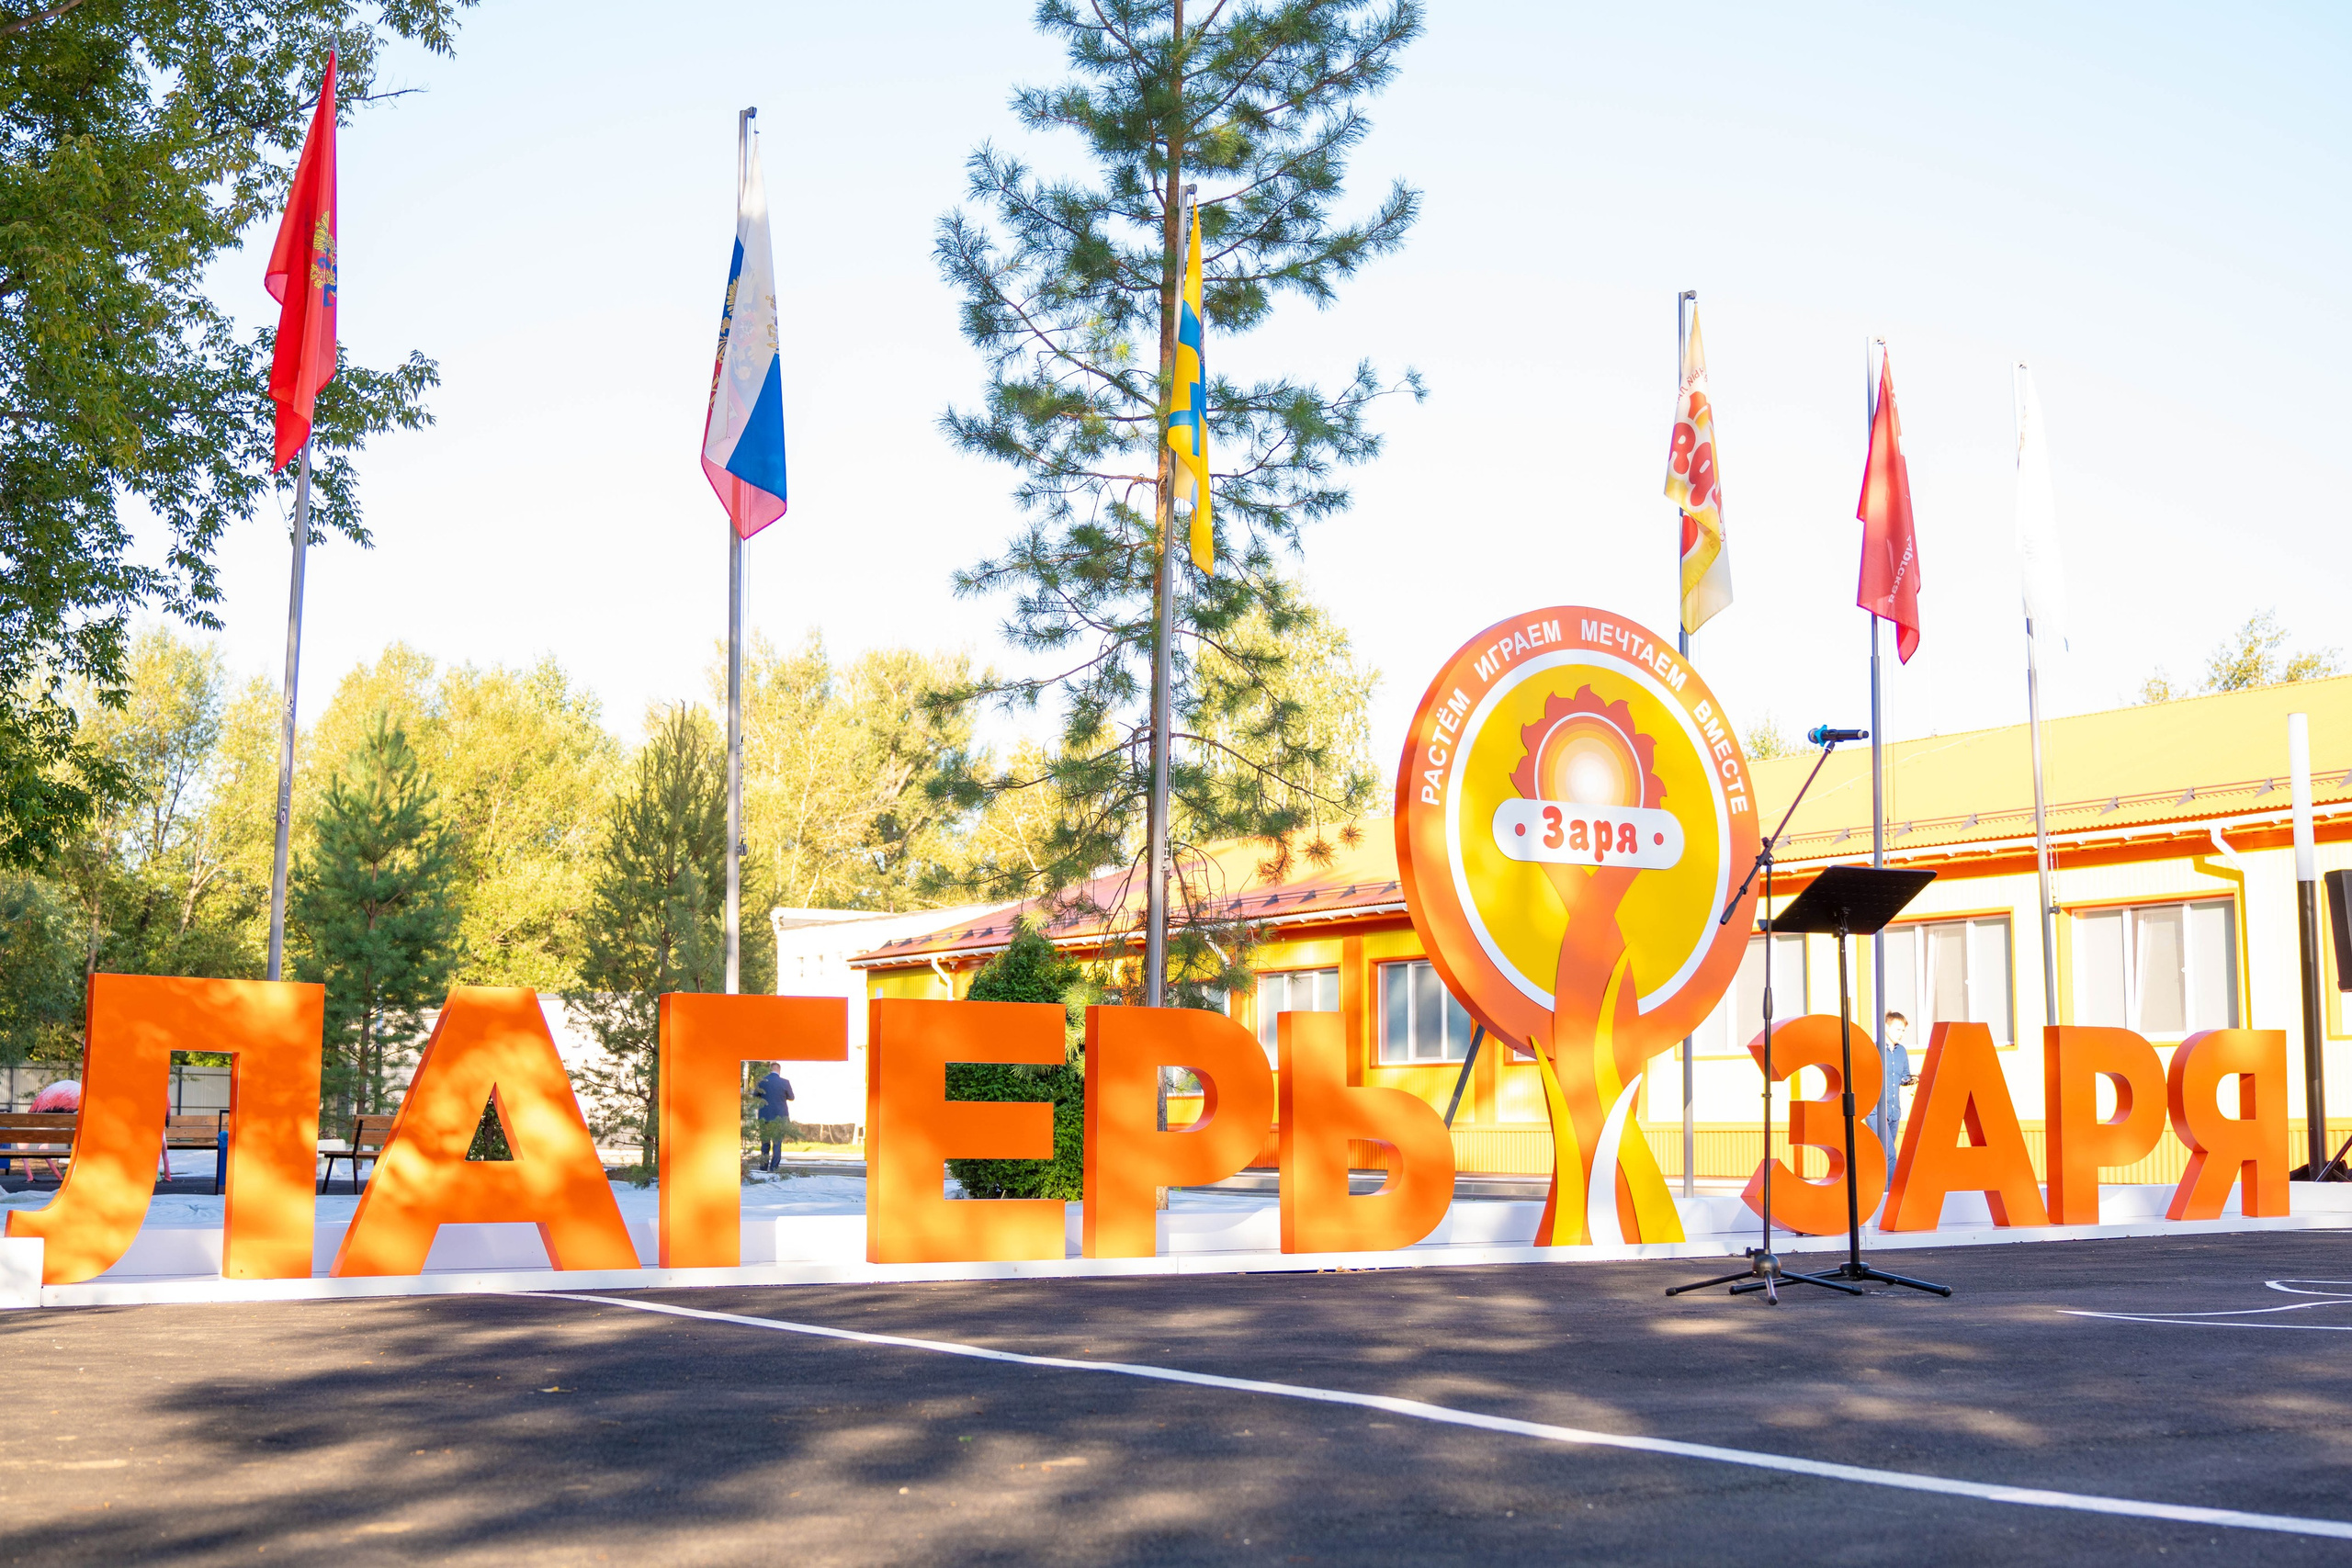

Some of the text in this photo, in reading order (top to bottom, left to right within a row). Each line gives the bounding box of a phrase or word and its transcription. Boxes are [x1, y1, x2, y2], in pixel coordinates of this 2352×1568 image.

[1421, 619, 1748, 815] РАСТЁМ ИГРАЕМ МЕЧТАЕМ ВМЕСТЕ
[1543, 806, 1638, 863] Заря
[5, 973, 2290, 1284] ЛАГЕРЬ ЗАРЯ
